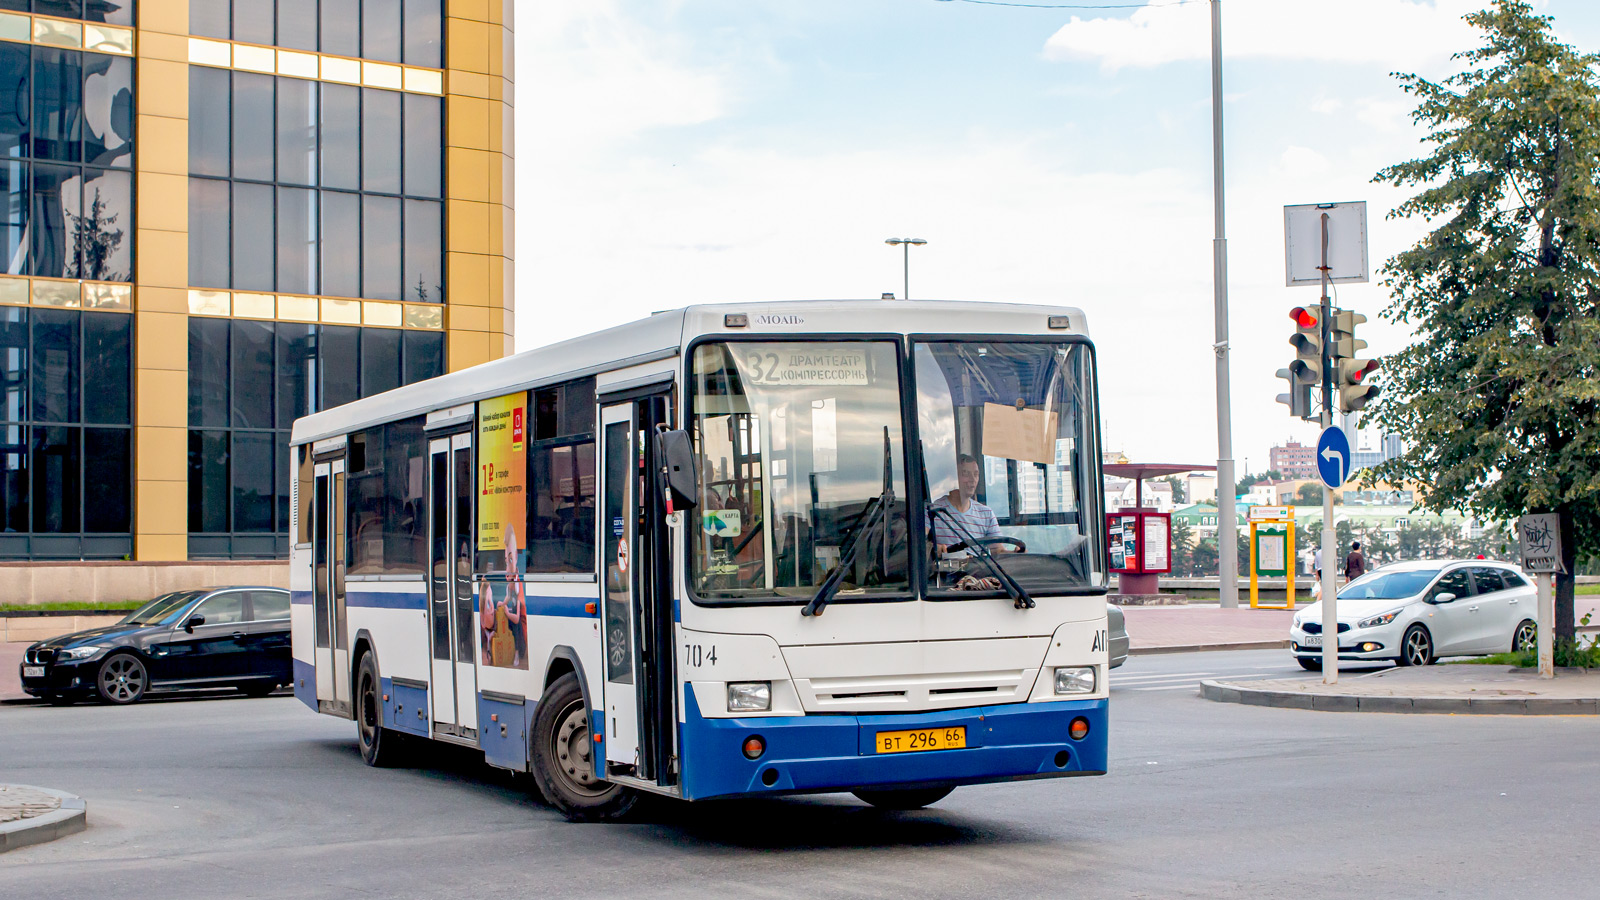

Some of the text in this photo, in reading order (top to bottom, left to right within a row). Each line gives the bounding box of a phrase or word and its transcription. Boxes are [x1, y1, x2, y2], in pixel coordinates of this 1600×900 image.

[755, 315, 804, 324] «МОАП»
[748, 352, 780, 382] 32
[789, 355, 861, 366] ДРАМТЕАТР
[482, 464, 488, 496] 1
[685, 644, 718, 668] 704
[884, 729, 960, 750] ВТ 296 66
